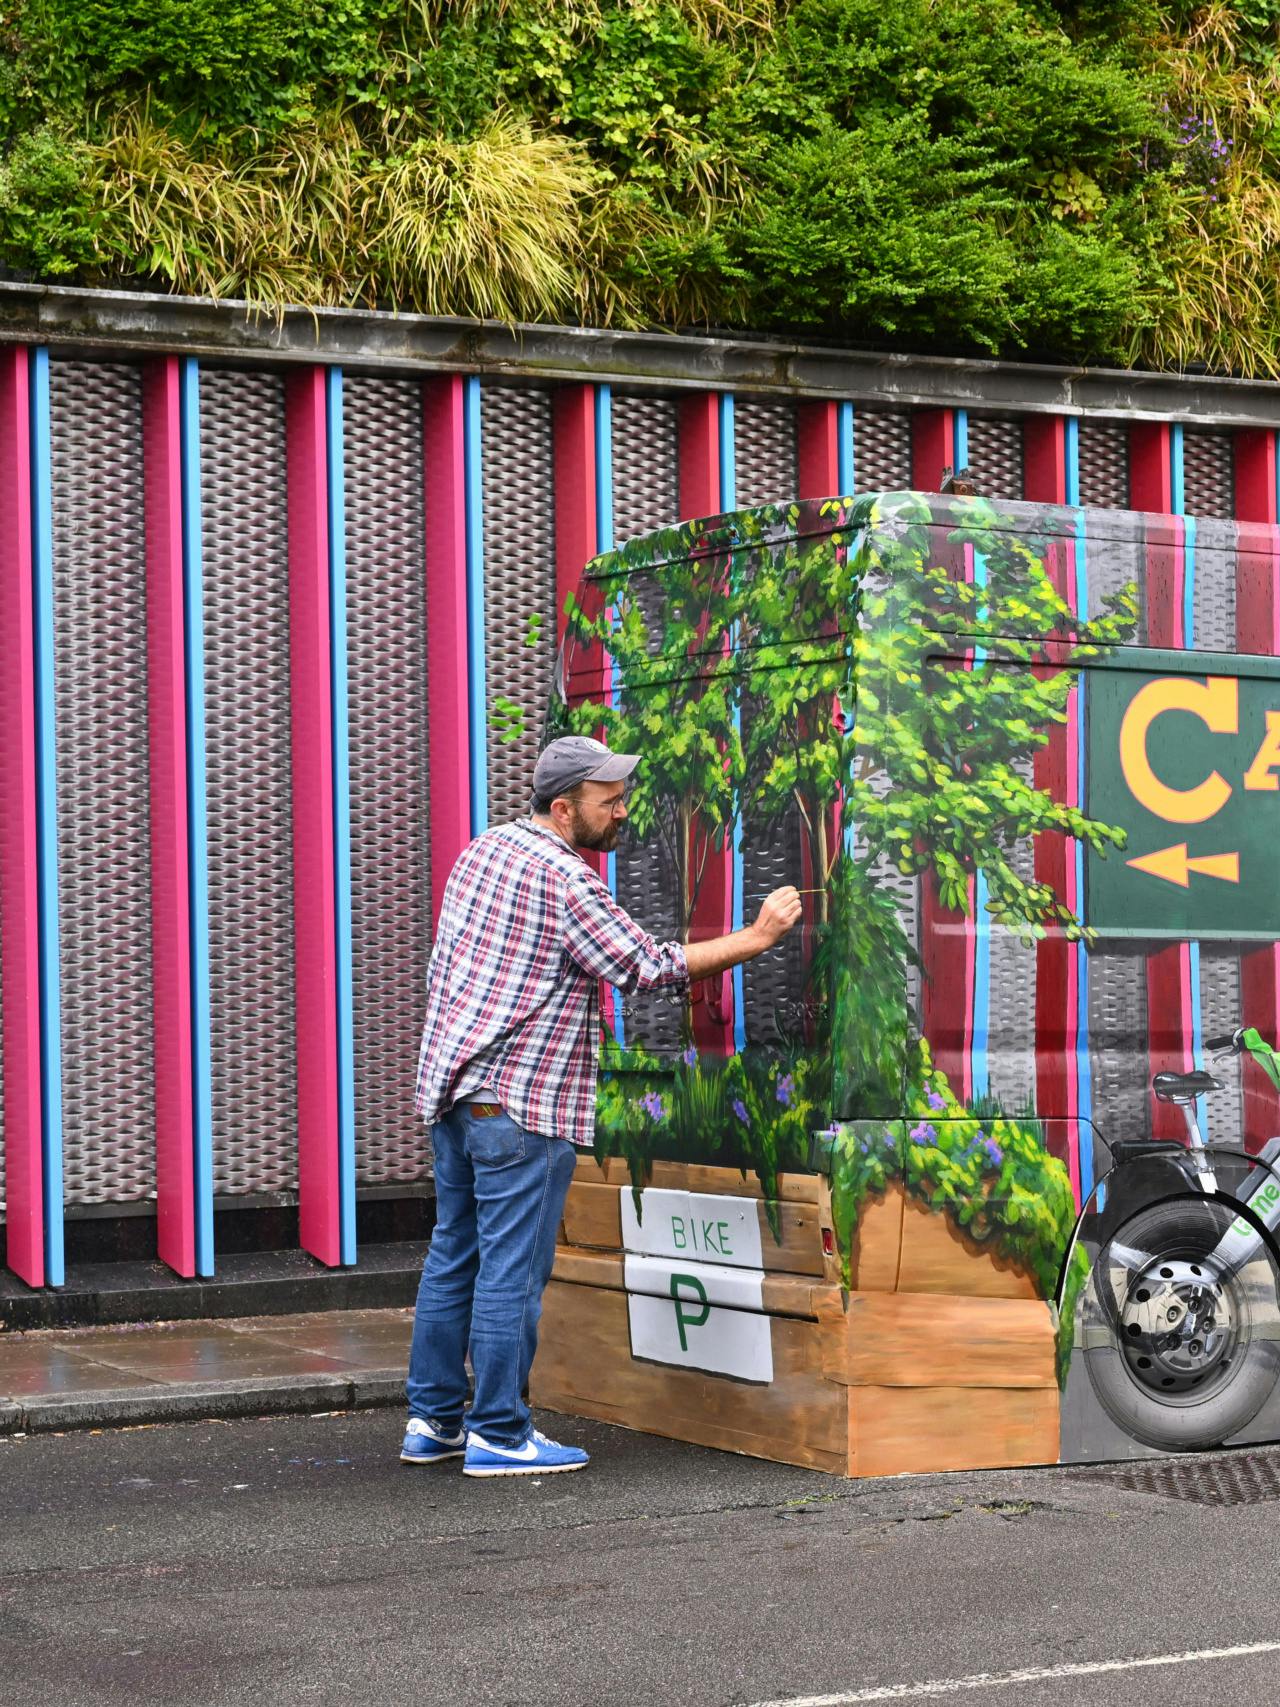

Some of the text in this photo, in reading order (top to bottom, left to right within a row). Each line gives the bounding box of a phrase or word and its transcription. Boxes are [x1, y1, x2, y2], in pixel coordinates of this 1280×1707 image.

[599, 1006, 640, 1018] EUGEOT
[671, 1216, 733, 1255] BIKE
[670, 1273, 711, 1351] P
